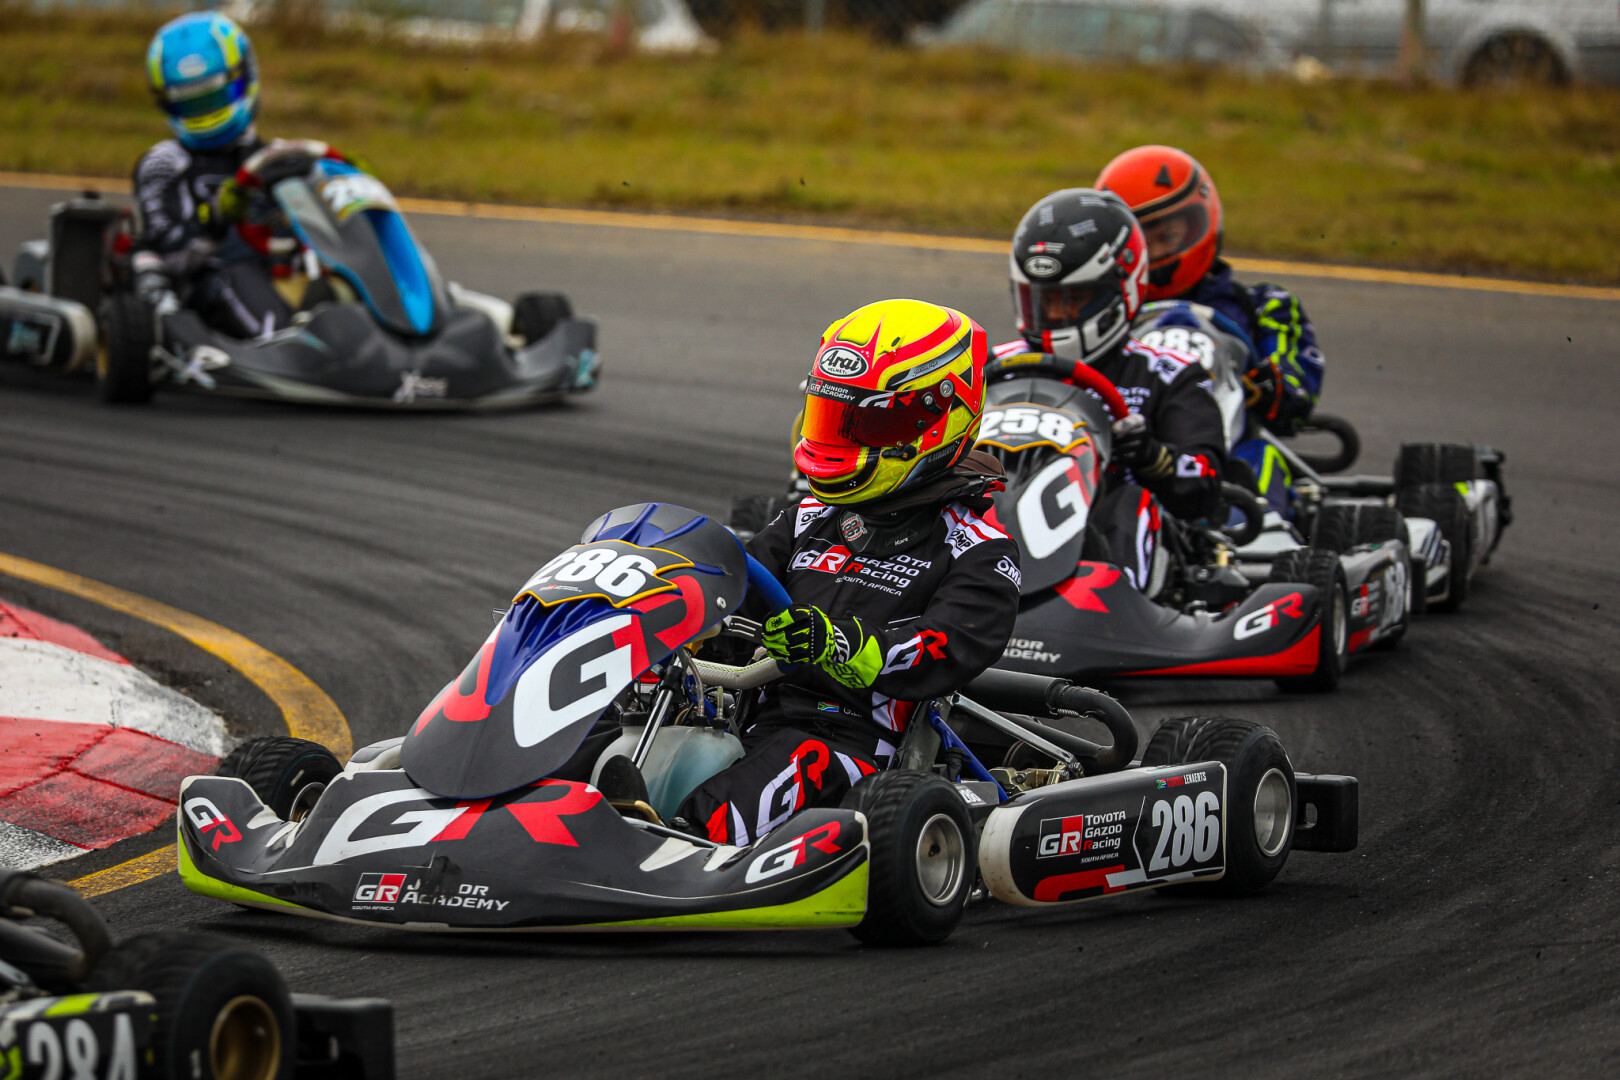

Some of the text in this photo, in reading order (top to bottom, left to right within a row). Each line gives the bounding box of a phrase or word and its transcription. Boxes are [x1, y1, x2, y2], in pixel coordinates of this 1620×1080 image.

[821, 350, 861, 371] Arai
[811, 383, 821, 392] GR
[820, 388, 856, 401] ACADEMY
[822, 383, 849, 394] JUNIOR
[976, 408, 1075, 447] 258
[792, 550, 847, 572] GR
[854, 556, 920, 577] GAZOO
[514, 548, 657, 597] 286
[843, 561, 911, 588] Racing
[867, 582, 902, 596] AFRICA
[1233, 592, 1304, 640] GR
[513, 574, 705, 748] GR
[879, 629, 948, 675] GR
[755, 739, 830, 838] GR
[184, 796, 243, 852] GR
[1085, 810, 1126, 826] TOYOTA
[1084, 823, 1123, 839] GAZOO
[1148, 790, 1220, 872] 286
[745, 820, 842, 884] GR
[1039, 830, 1081, 856] GR
[1083, 837, 1121, 851] Racing
[1081, 852, 1119, 864] SOUTH AFRICA
[355, 884, 400, 901] GR
